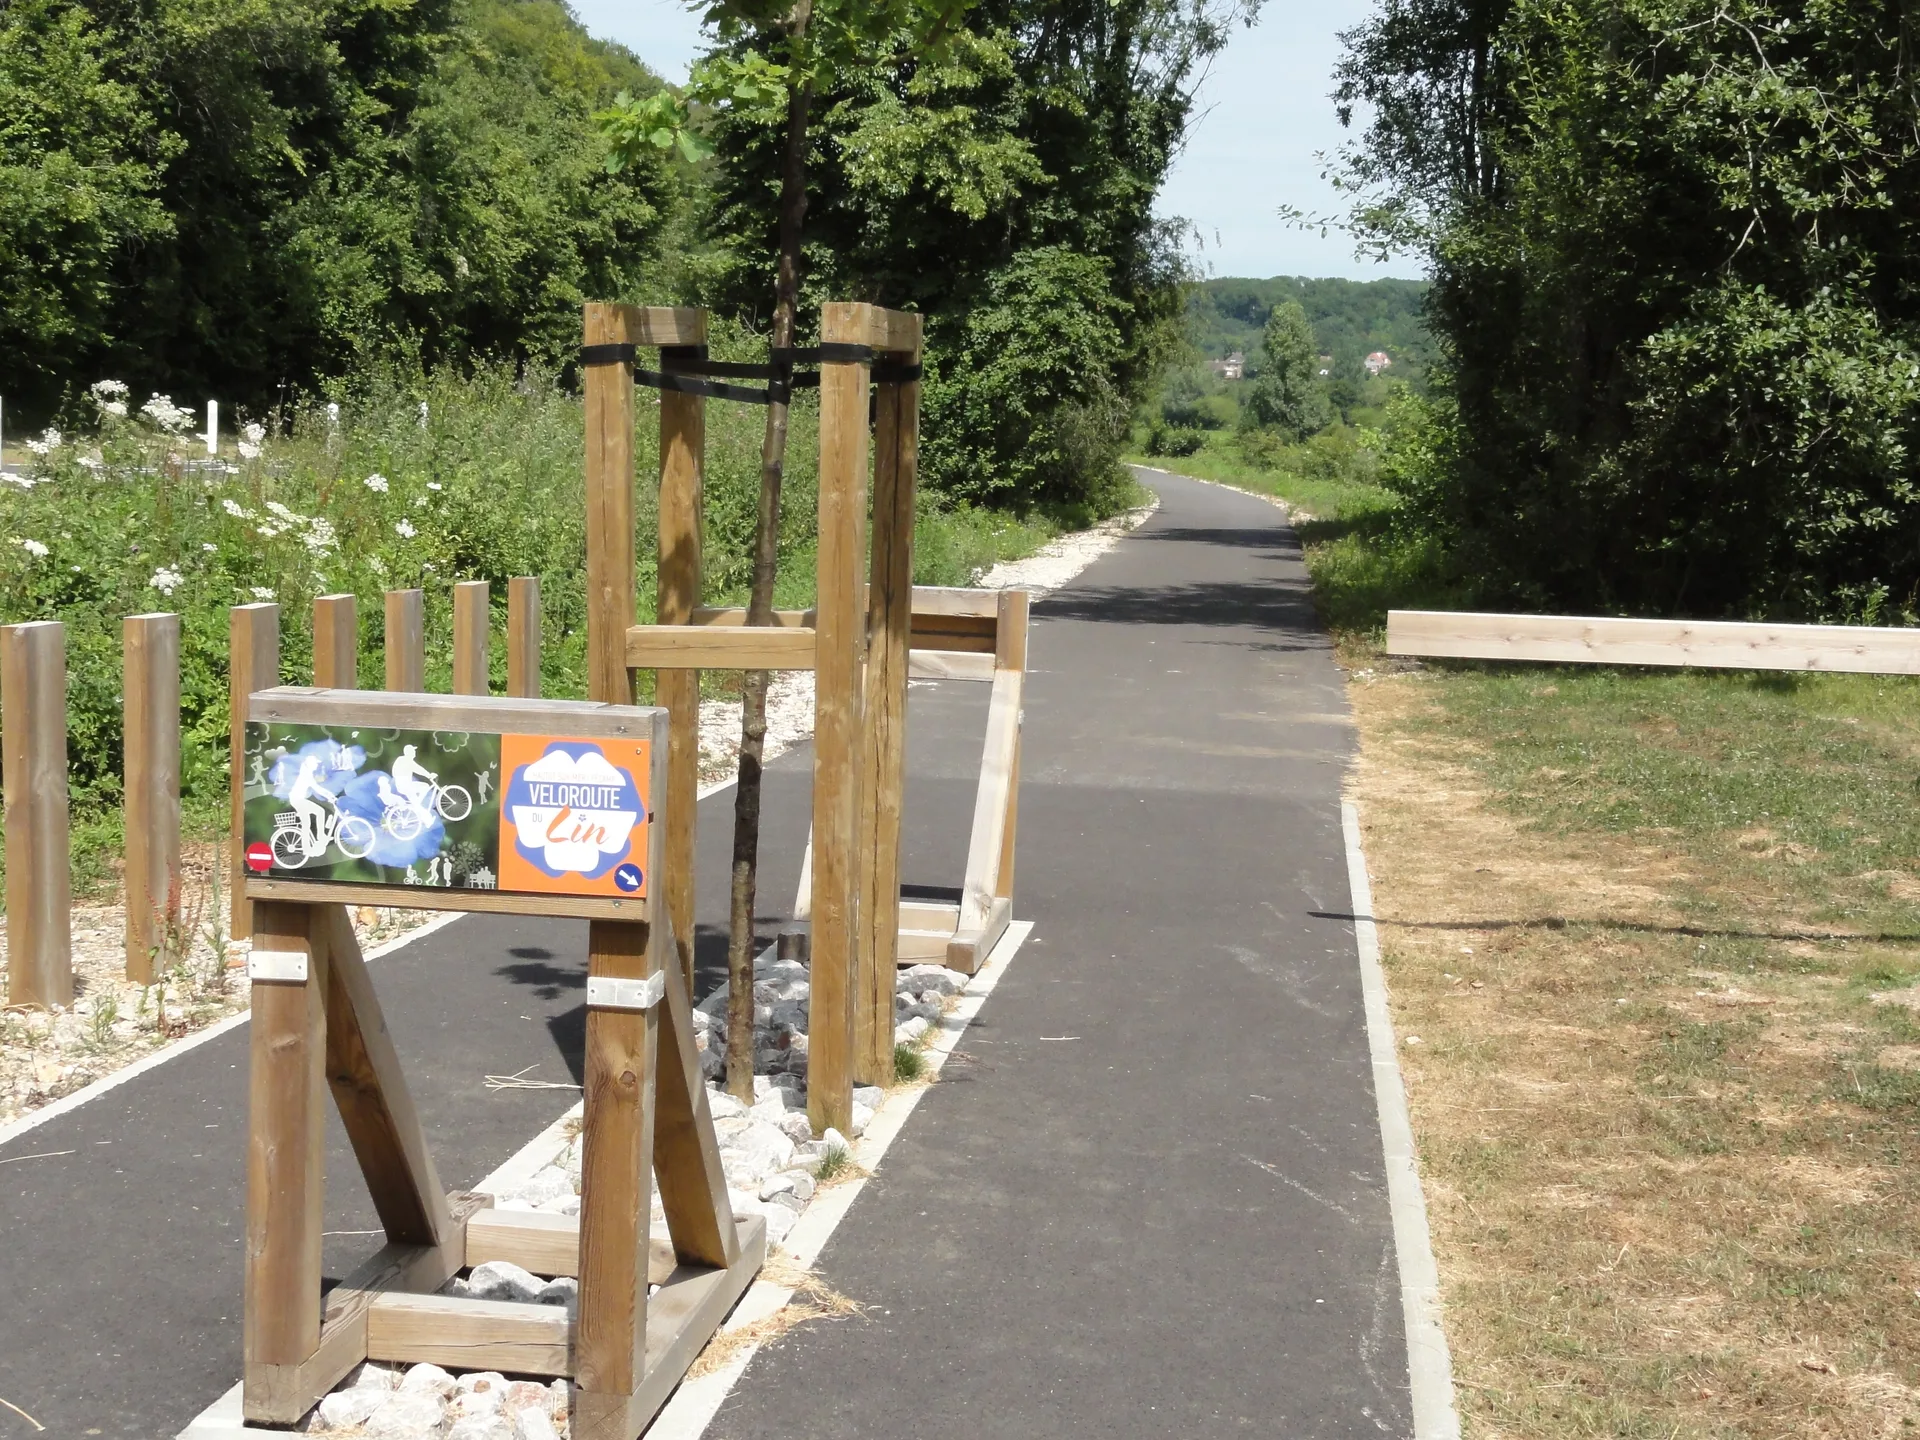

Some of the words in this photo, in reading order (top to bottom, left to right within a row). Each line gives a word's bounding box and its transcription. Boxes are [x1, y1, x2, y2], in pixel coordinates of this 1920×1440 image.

[529, 783, 621, 809] VELOROUTE
[532, 812, 543, 823] DU
[546, 805, 609, 845] Lin
